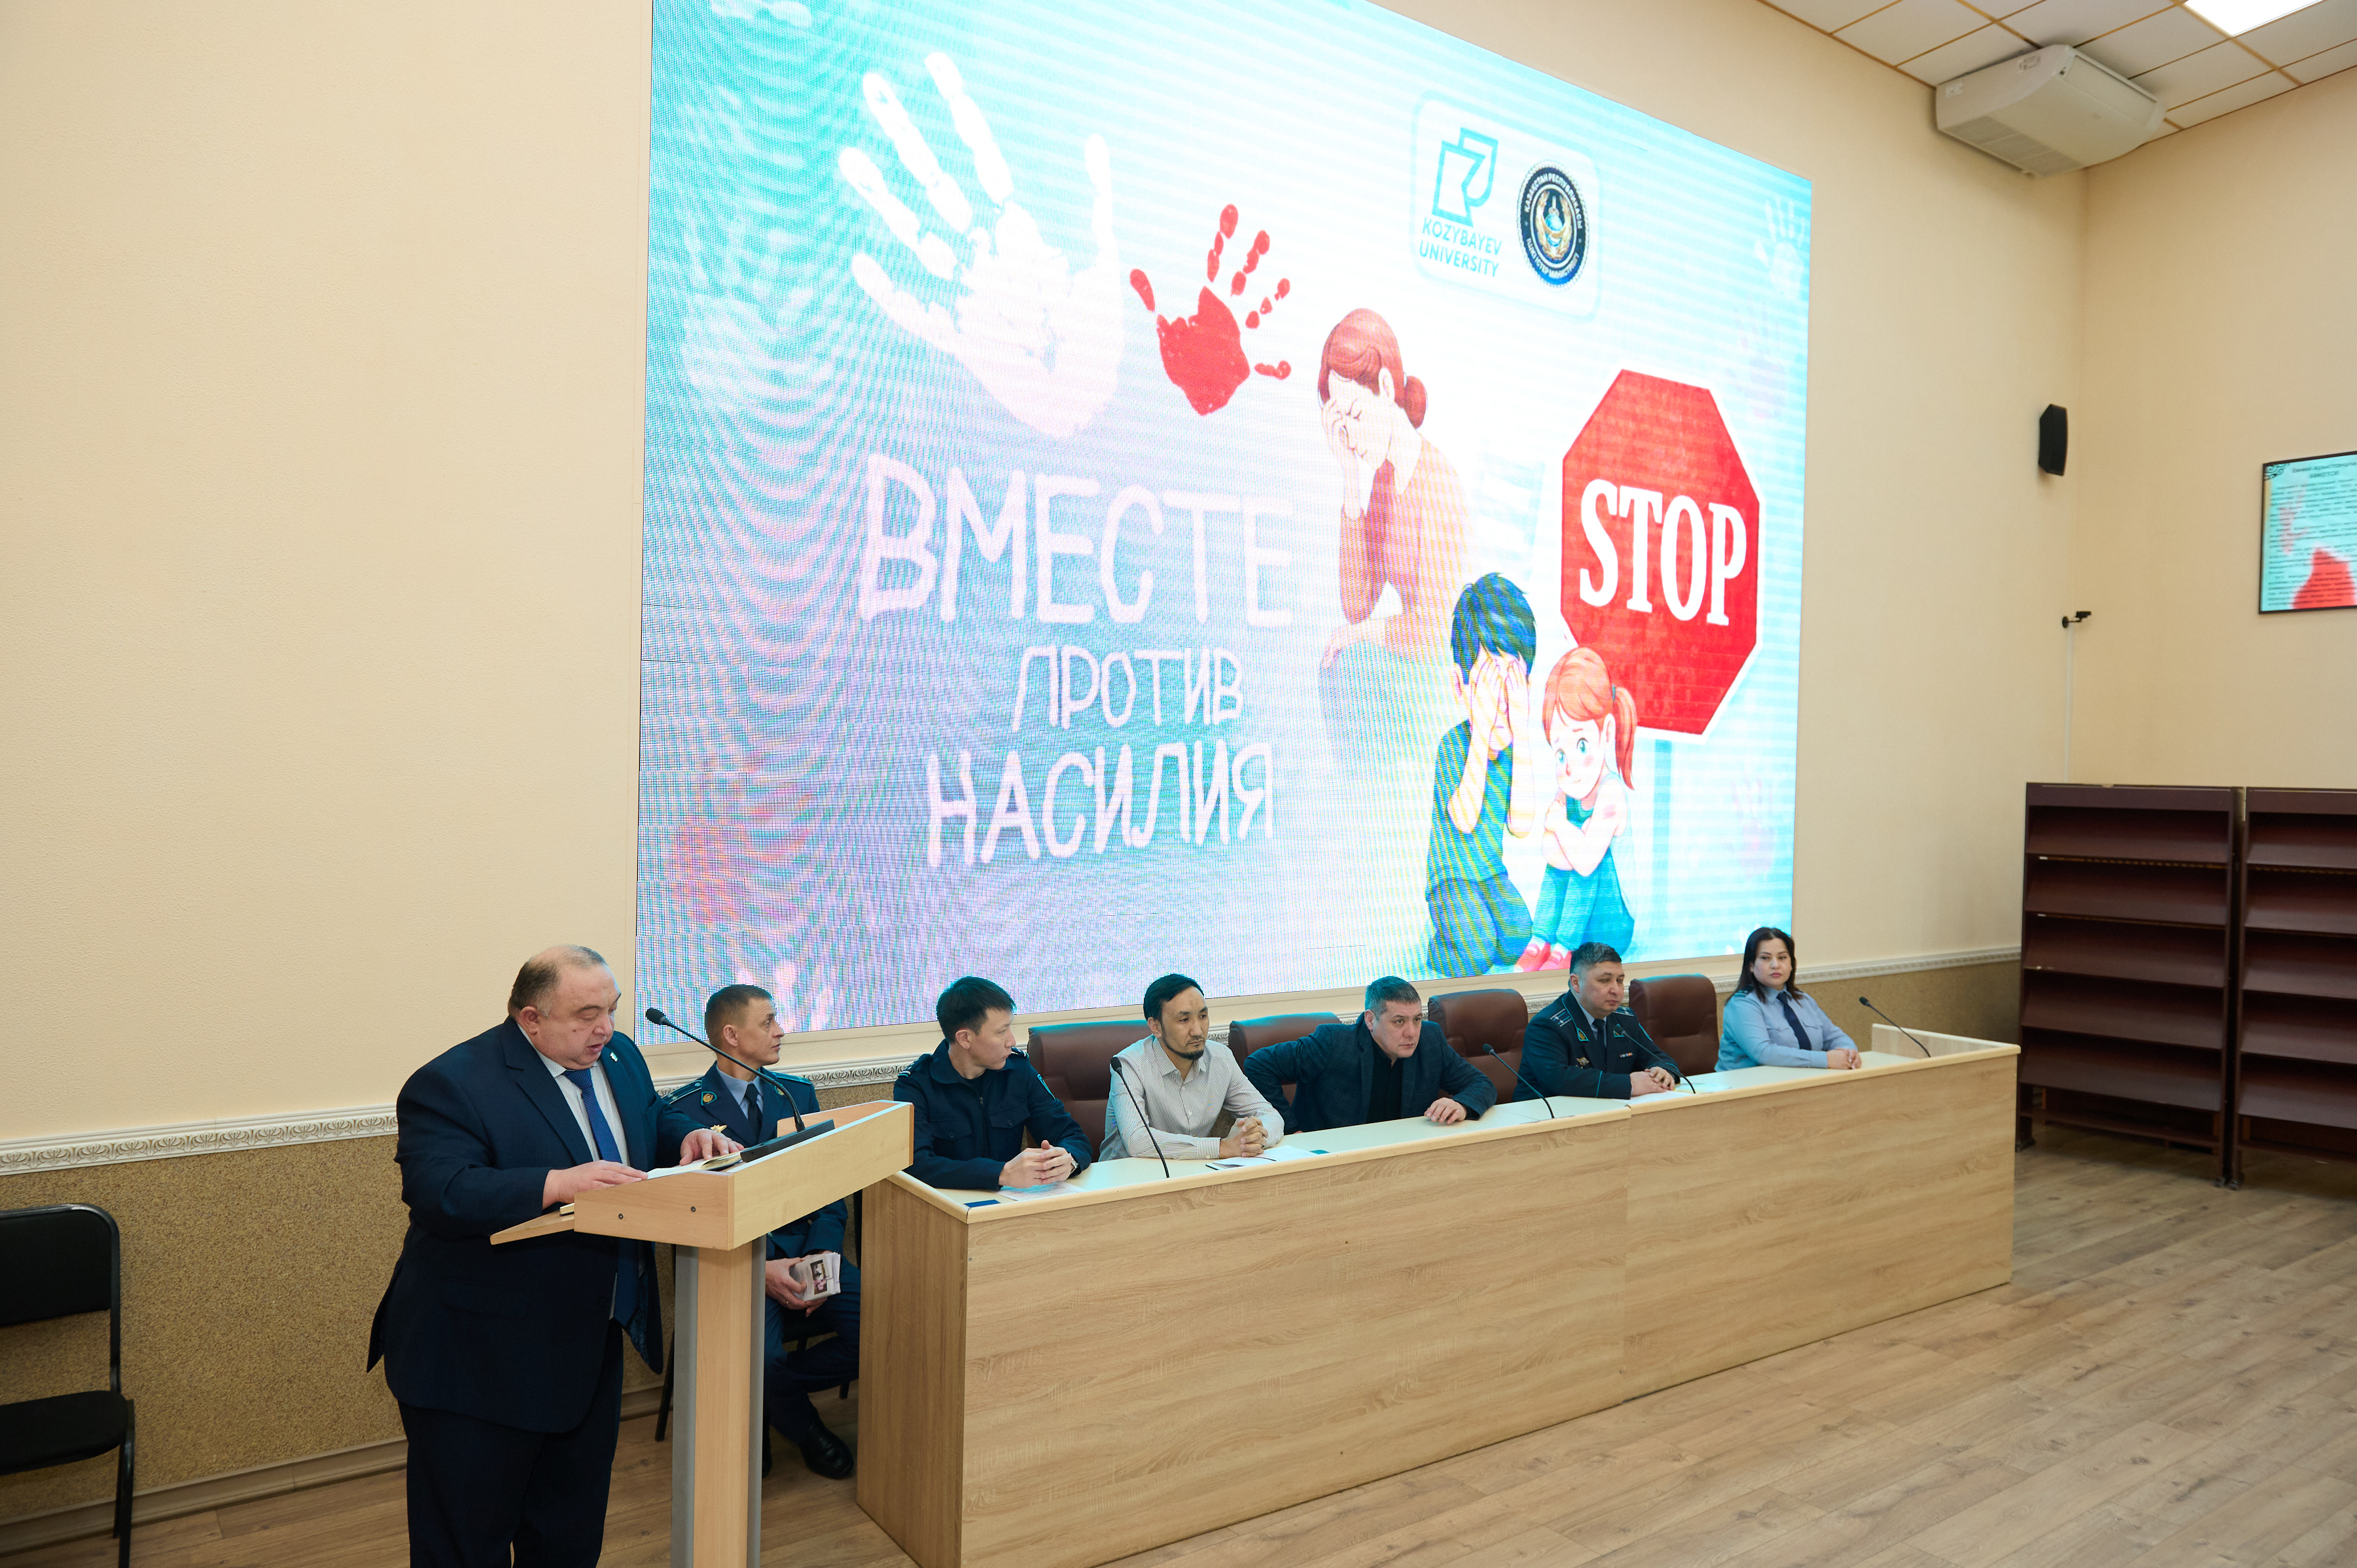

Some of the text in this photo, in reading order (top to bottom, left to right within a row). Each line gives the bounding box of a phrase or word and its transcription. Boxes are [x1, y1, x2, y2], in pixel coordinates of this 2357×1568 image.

[1419, 240, 1499, 277] UNIVERSITY
[1422, 217, 1502, 255] KOZYBAYEV
[858, 453, 1296, 627] ВМЕСТЕ
[1580, 479, 1746, 626] STOP
[1010, 645, 1245, 731] ПРОТИВ
[926, 738, 1274, 867] НАСИЛИЯ
